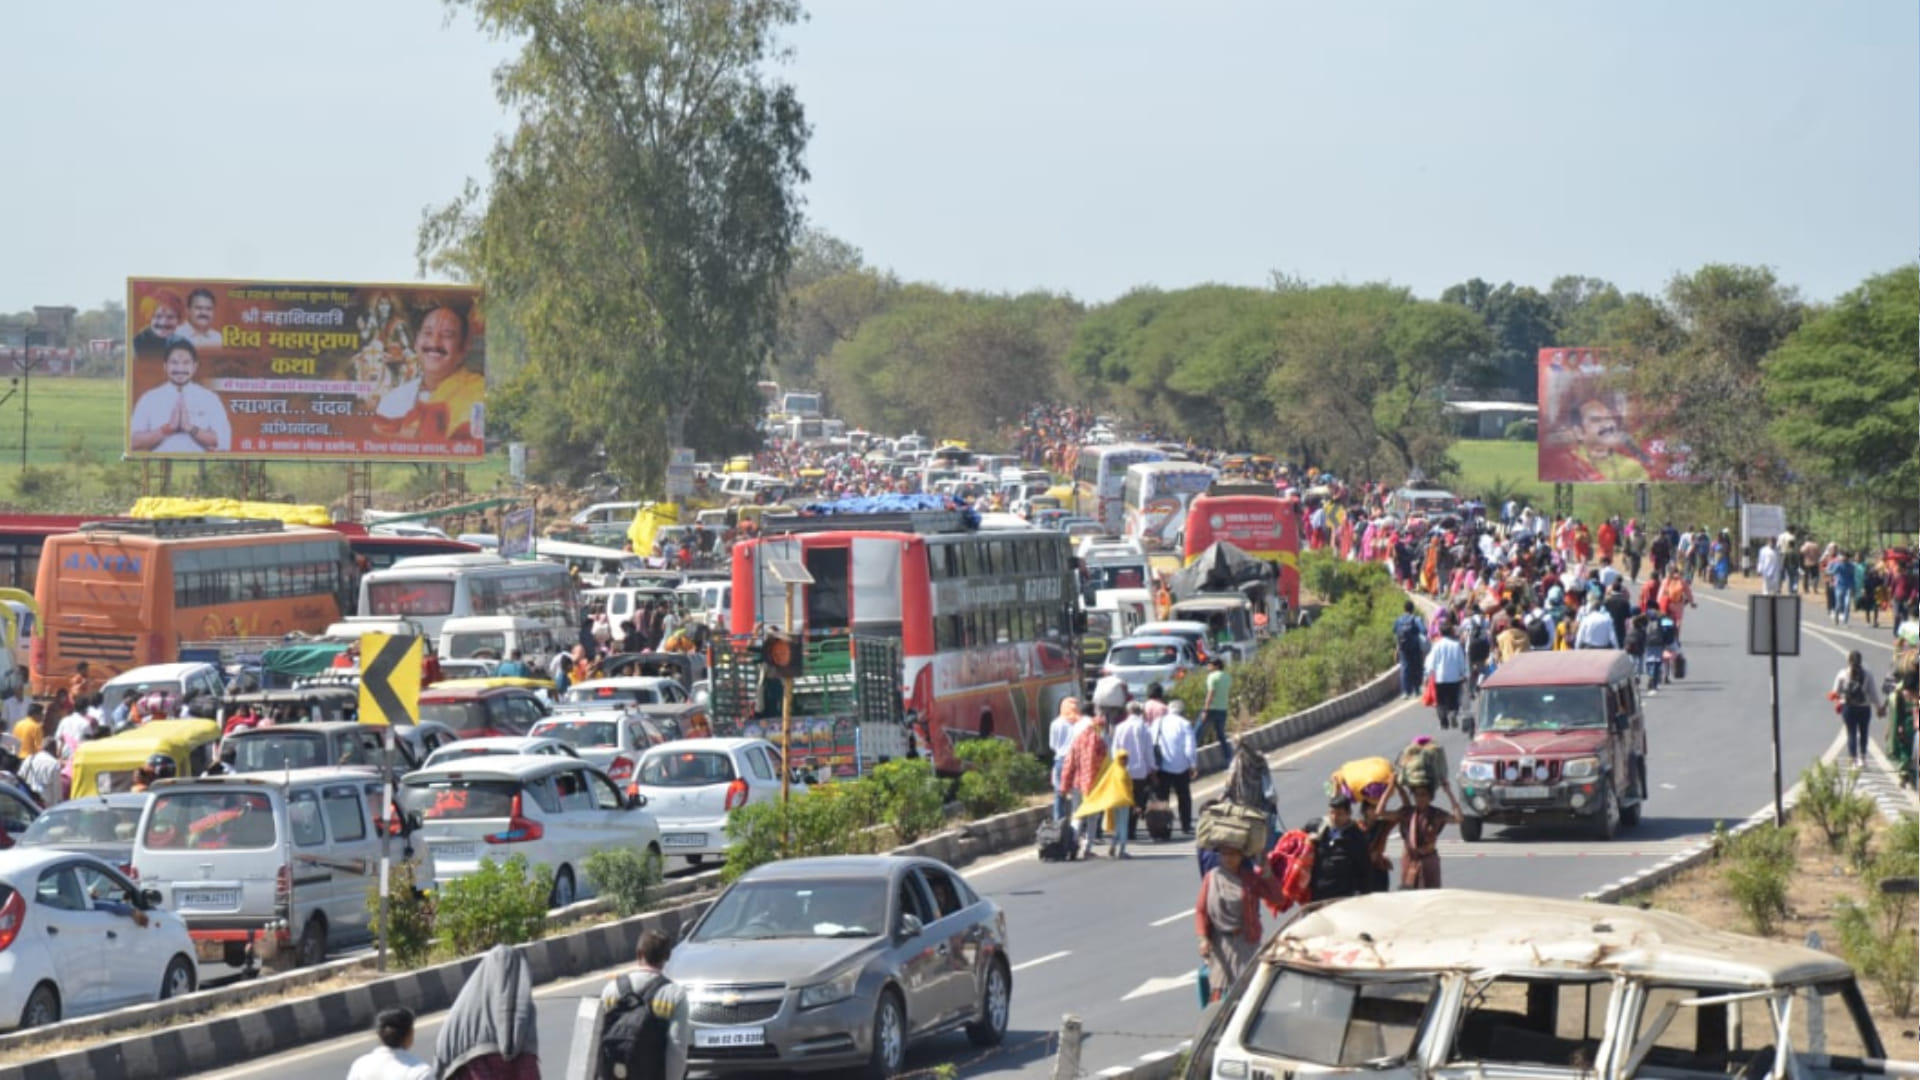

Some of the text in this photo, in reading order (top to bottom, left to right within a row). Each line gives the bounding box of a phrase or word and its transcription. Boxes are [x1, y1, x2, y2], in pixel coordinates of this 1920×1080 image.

[263, 307, 344, 326] महाशिवरात्रि
[222, 325, 358, 354] शिव महापुराण
[271, 357, 316, 375] कथा
